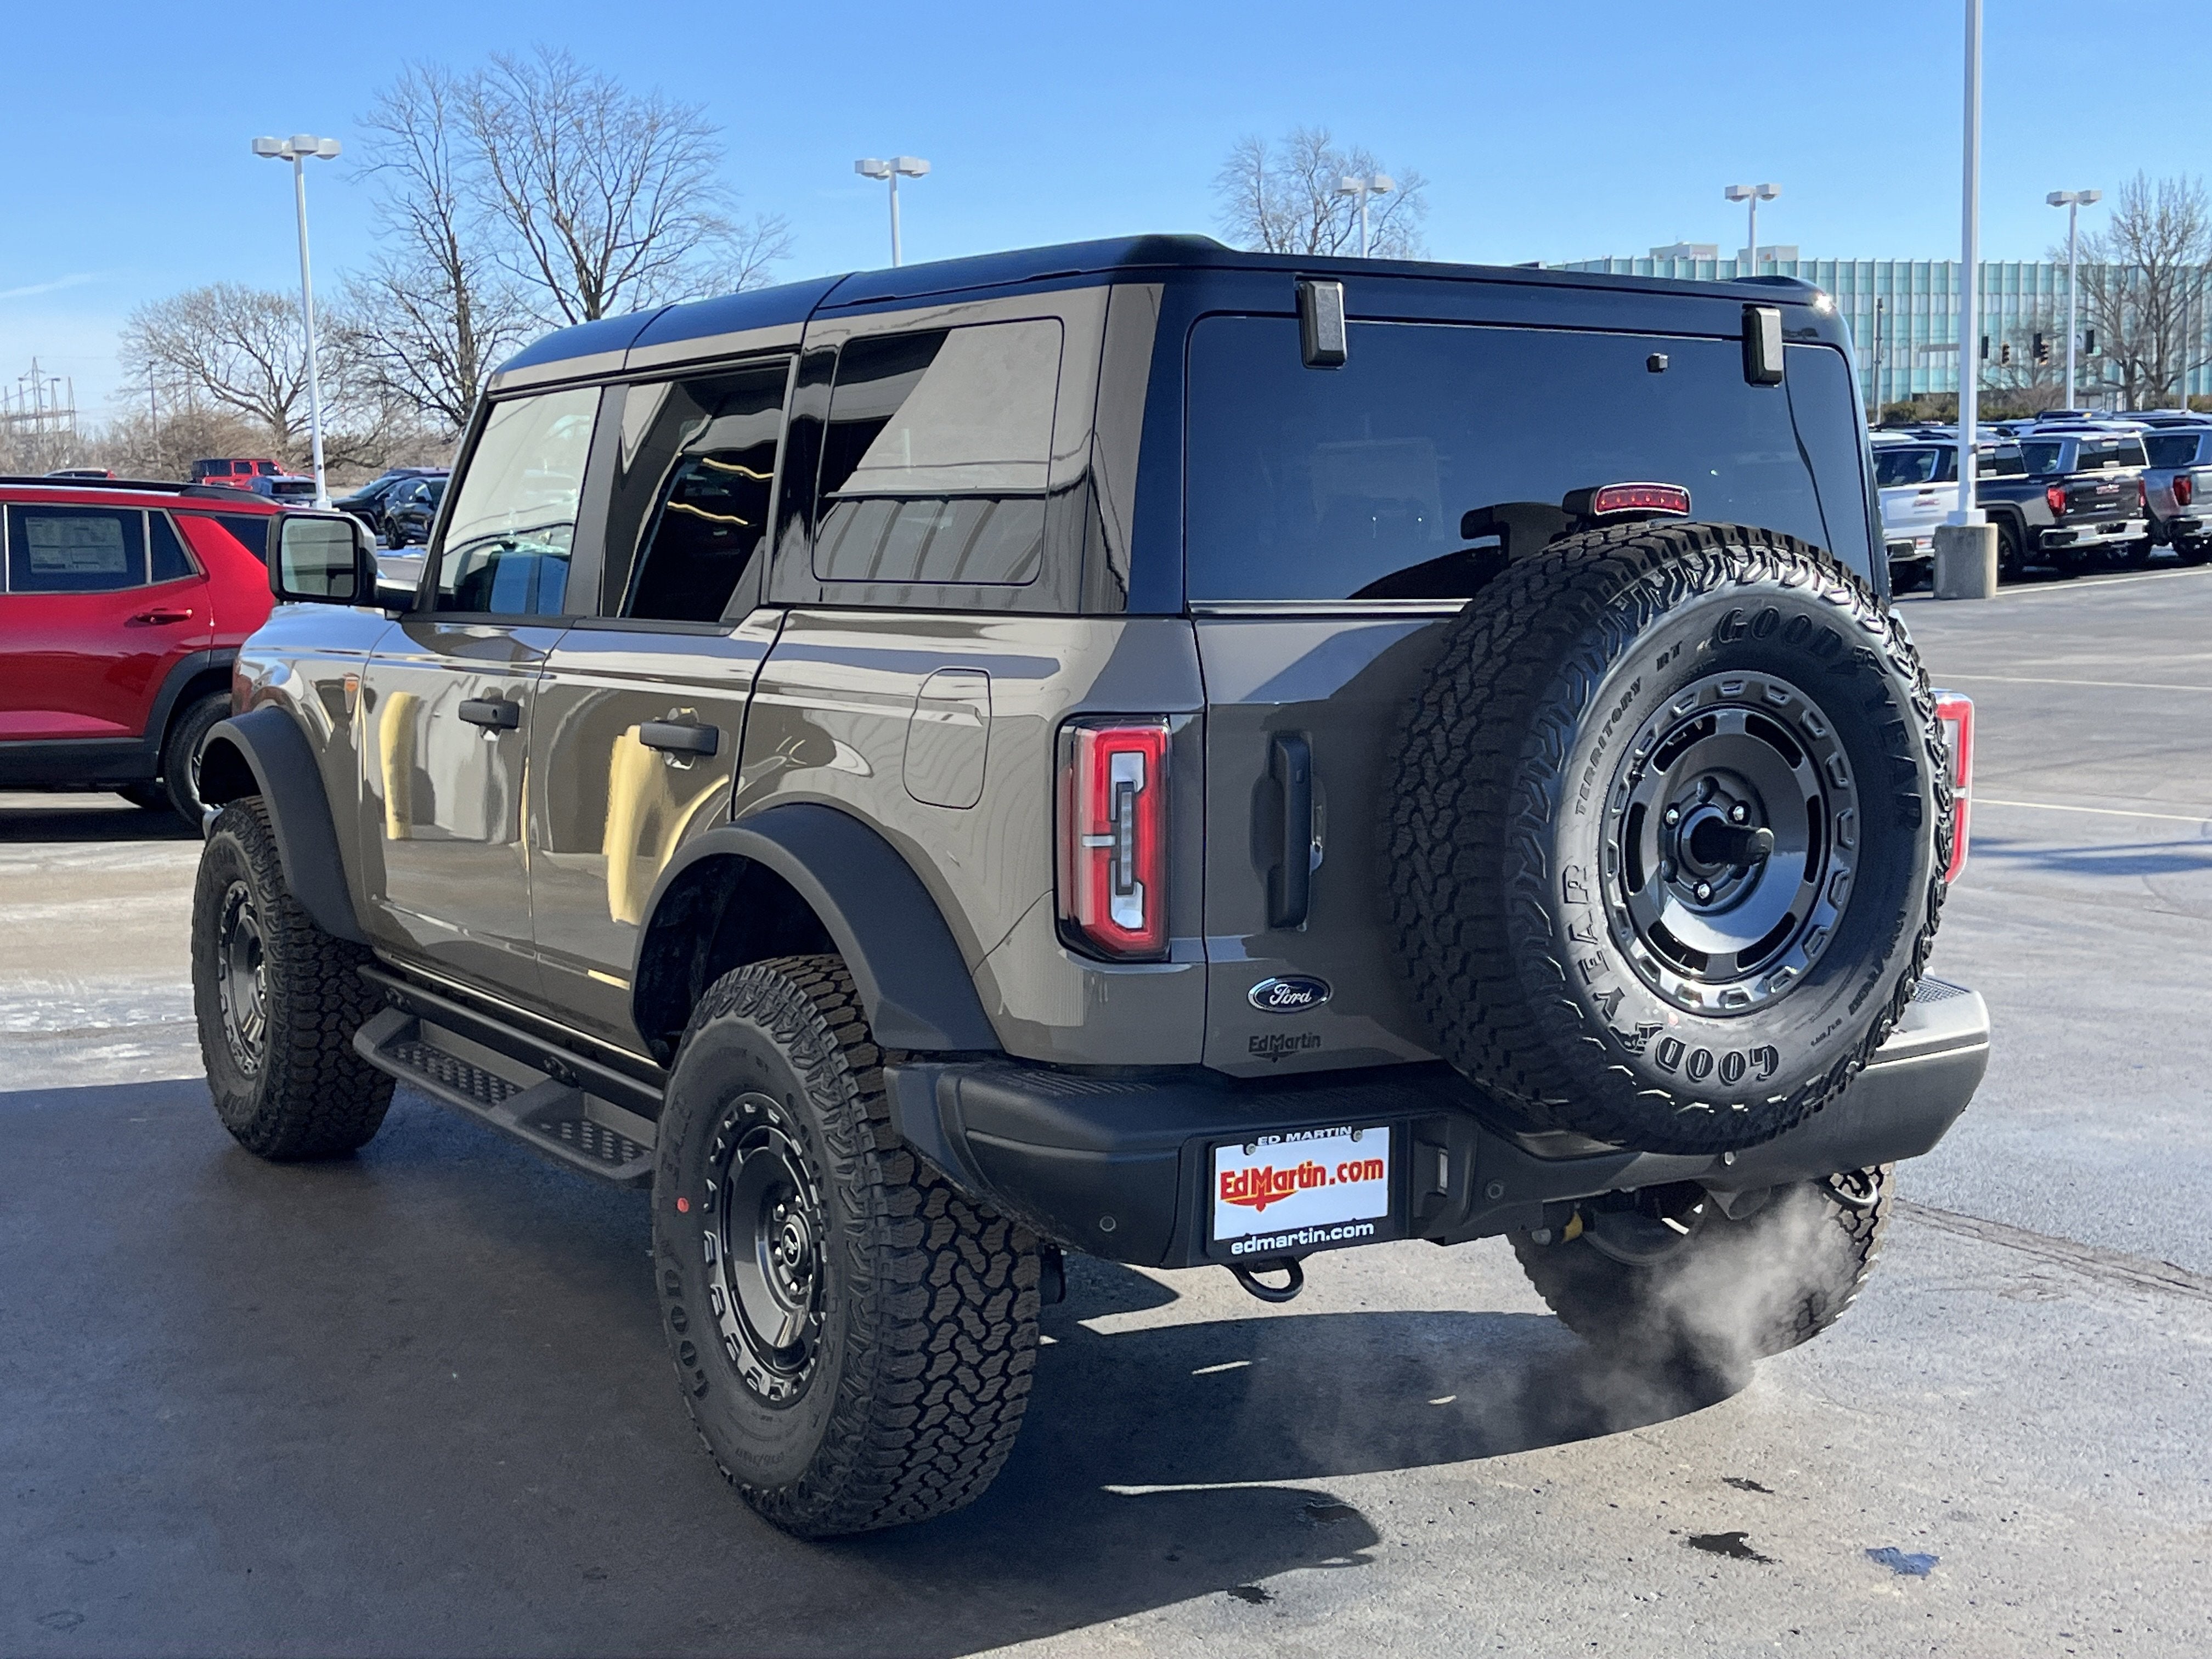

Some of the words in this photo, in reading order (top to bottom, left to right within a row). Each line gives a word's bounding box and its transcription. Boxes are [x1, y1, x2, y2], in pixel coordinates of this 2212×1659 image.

[1575, 676, 1642, 815] TERRITORY
[1269, 984, 1313, 1005] Ford
[1248, 1031, 1321, 1053] EdMartin
[1257, 1135, 1281, 1146] ED
[1285, 1126, 1352, 1143] MARTIN
[1220, 1158, 1384, 1200] EdMartin.com
[1231, 1222, 1375, 1255] edmartin.com
